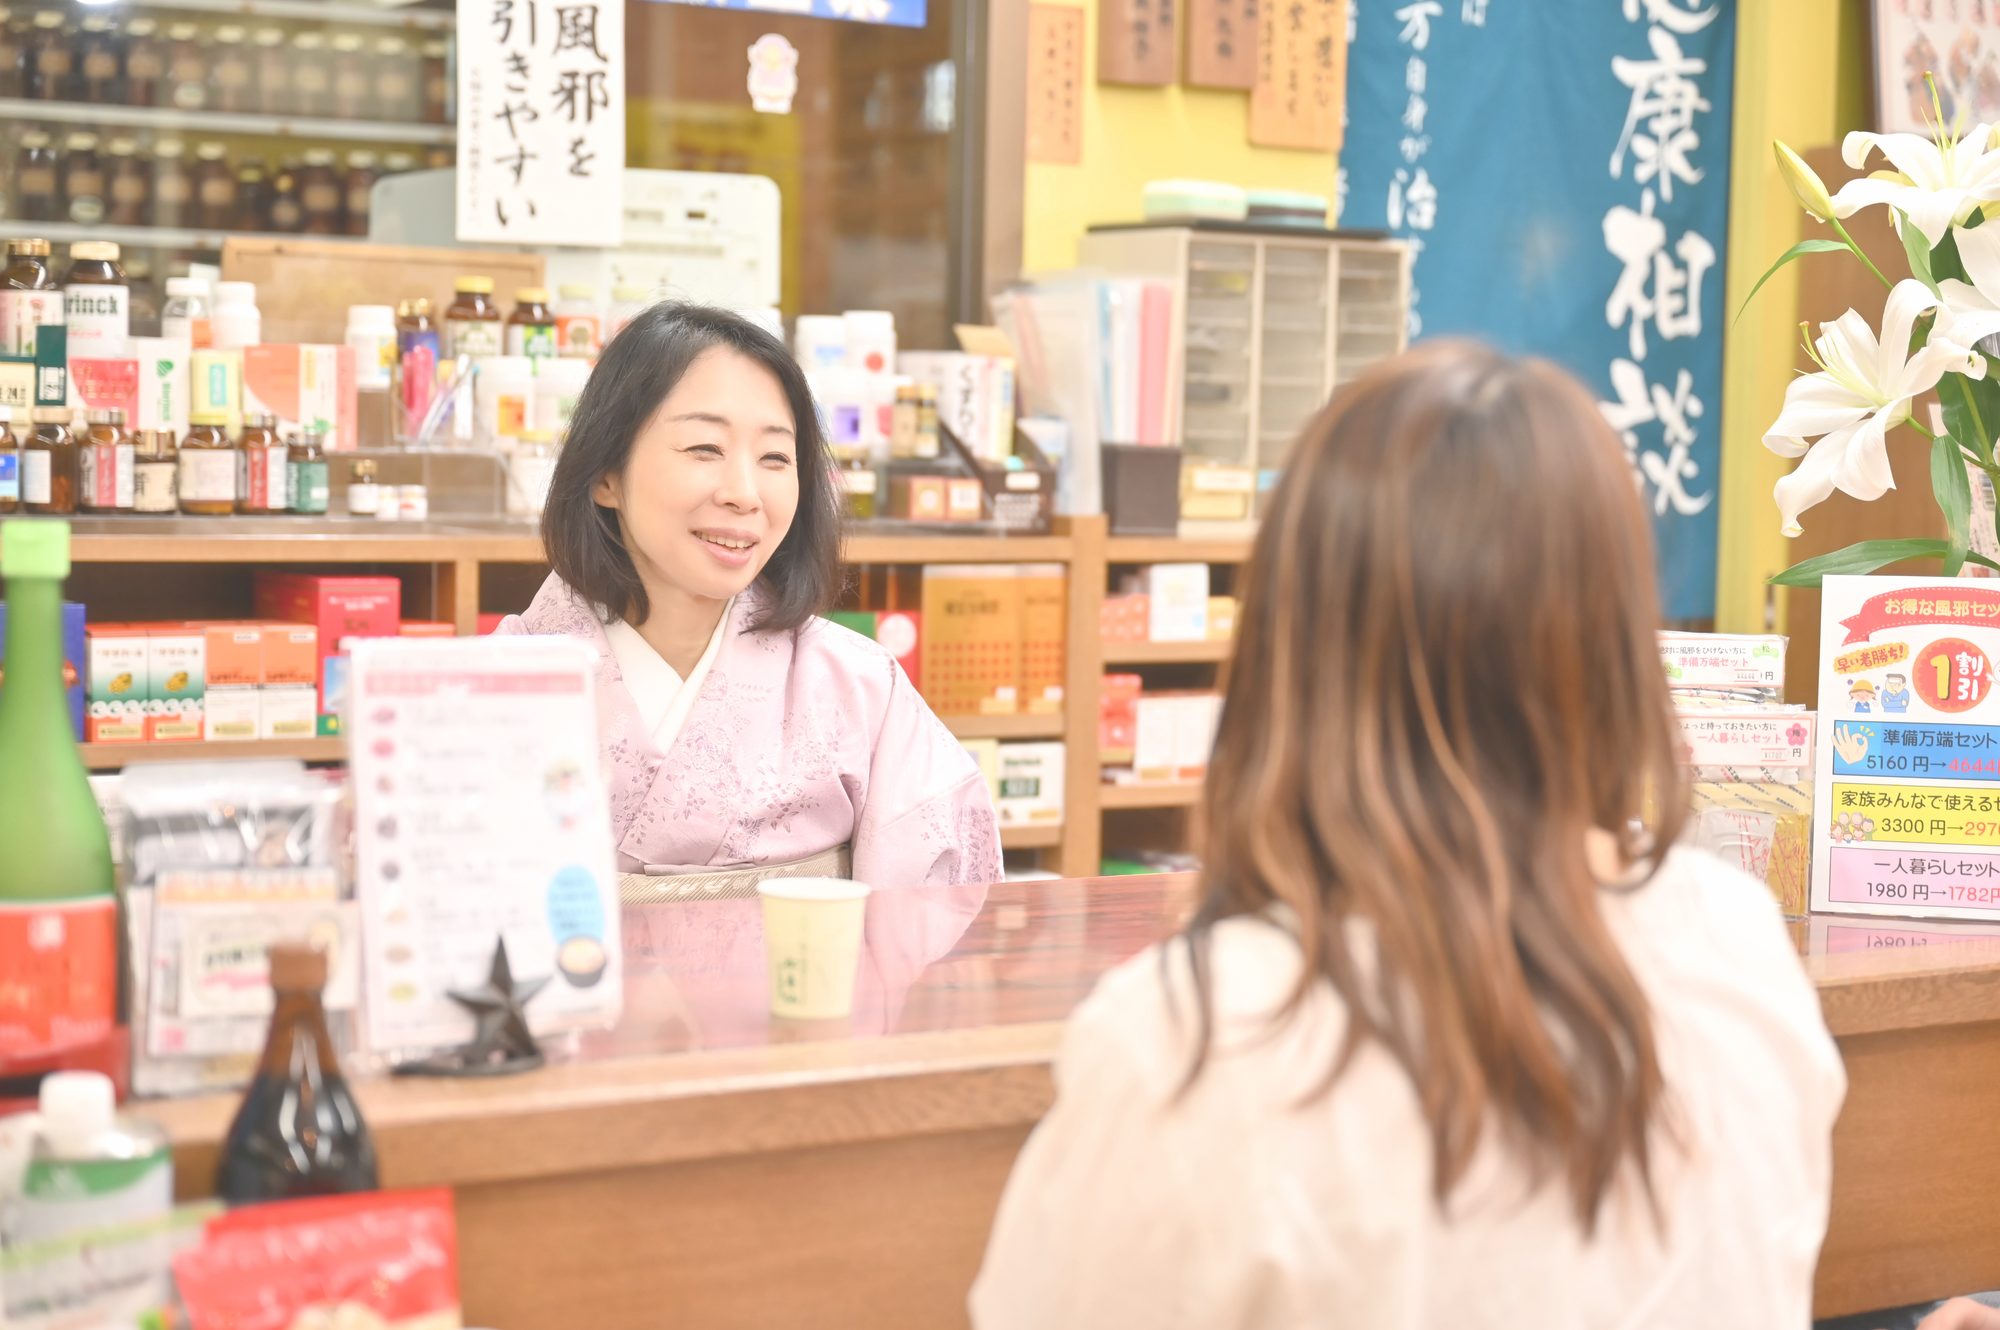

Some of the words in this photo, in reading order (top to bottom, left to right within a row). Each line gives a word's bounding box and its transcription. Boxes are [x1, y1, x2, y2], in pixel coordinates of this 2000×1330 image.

[552, 5, 608, 177] 風邪を
[490, 0, 540, 228] 引きやすい
[1679, 657, 1749, 668] 準備万端セット
[1837, 645, 1904, 672] 早い者勝ち!
[1930, 654, 1950, 699] 1
[1697, 732, 1782, 744] 一人暮らしセット
[1883, 728, 1998, 749] 準備万端セット
[1866, 755, 1907, 770] 5160
[1948, 757, 2000, 774] 4644
[1881, 818, 1924, 833] 3300
[1874, 857, 2000, 877] 一人暮らしセット
[1866, 882, 1907, 898] 1980
